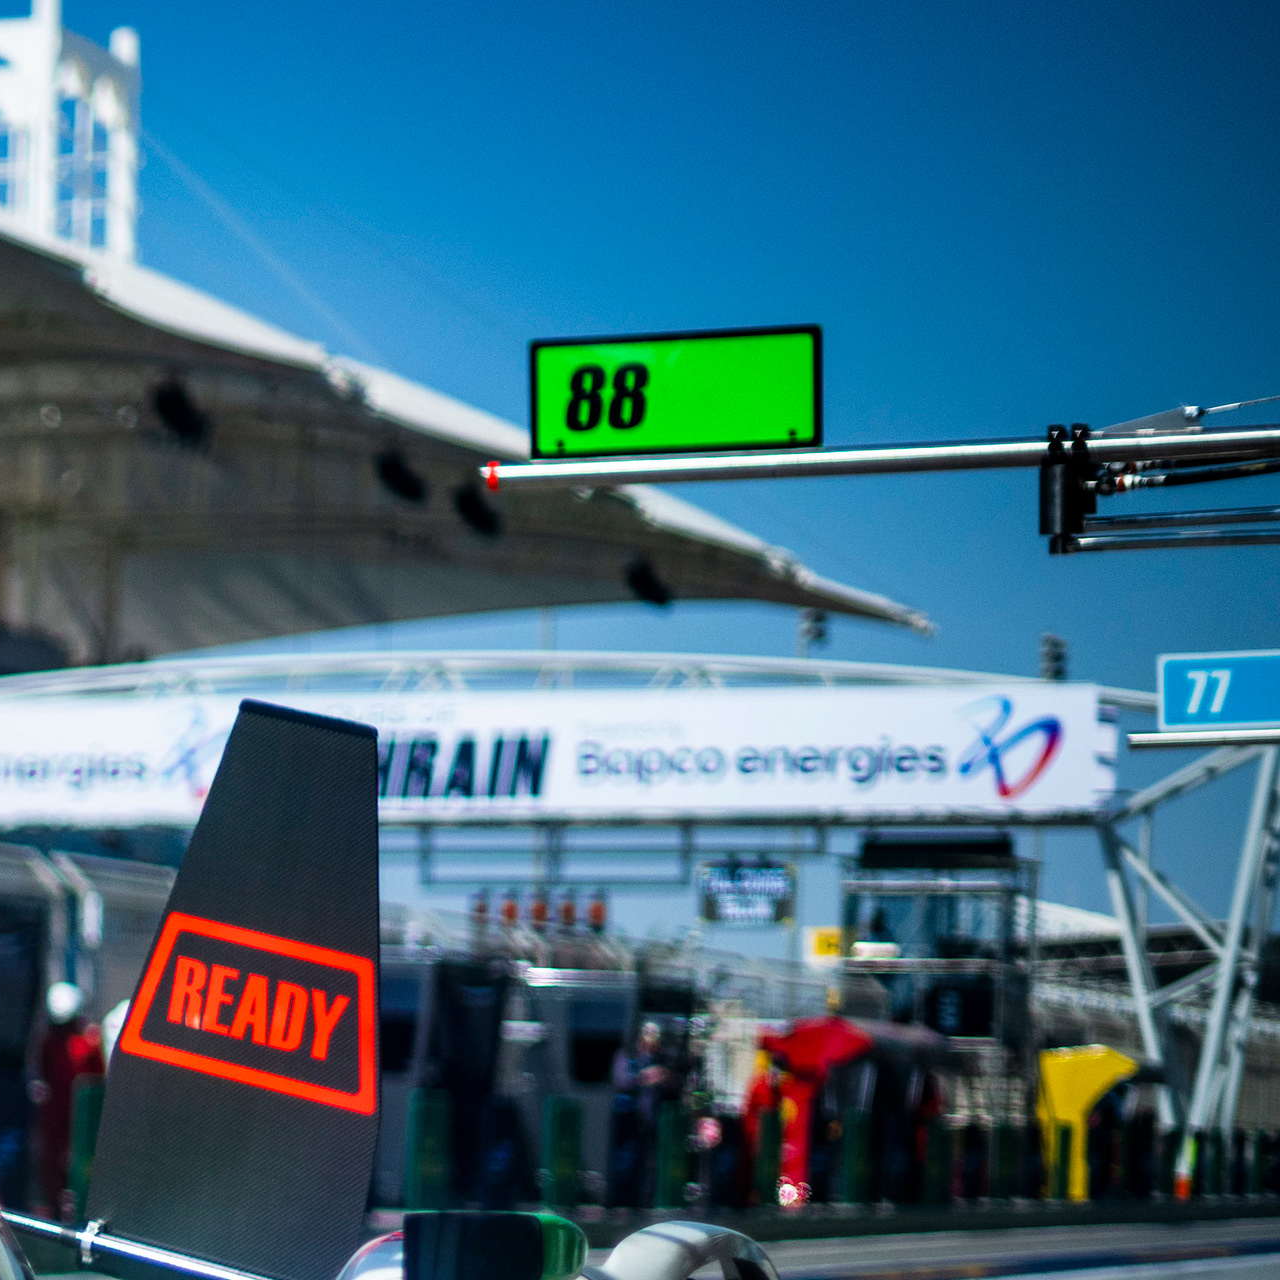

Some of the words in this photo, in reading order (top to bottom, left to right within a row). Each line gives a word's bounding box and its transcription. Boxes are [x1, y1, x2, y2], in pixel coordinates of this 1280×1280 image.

[566, 362, 650, 431] 88
[1186, 669, 1231, 714] 77
[577, 739, 726, 786] Bapco
[735, 728, 948, 790] energies
[166, 955, 351, 1061] READY
